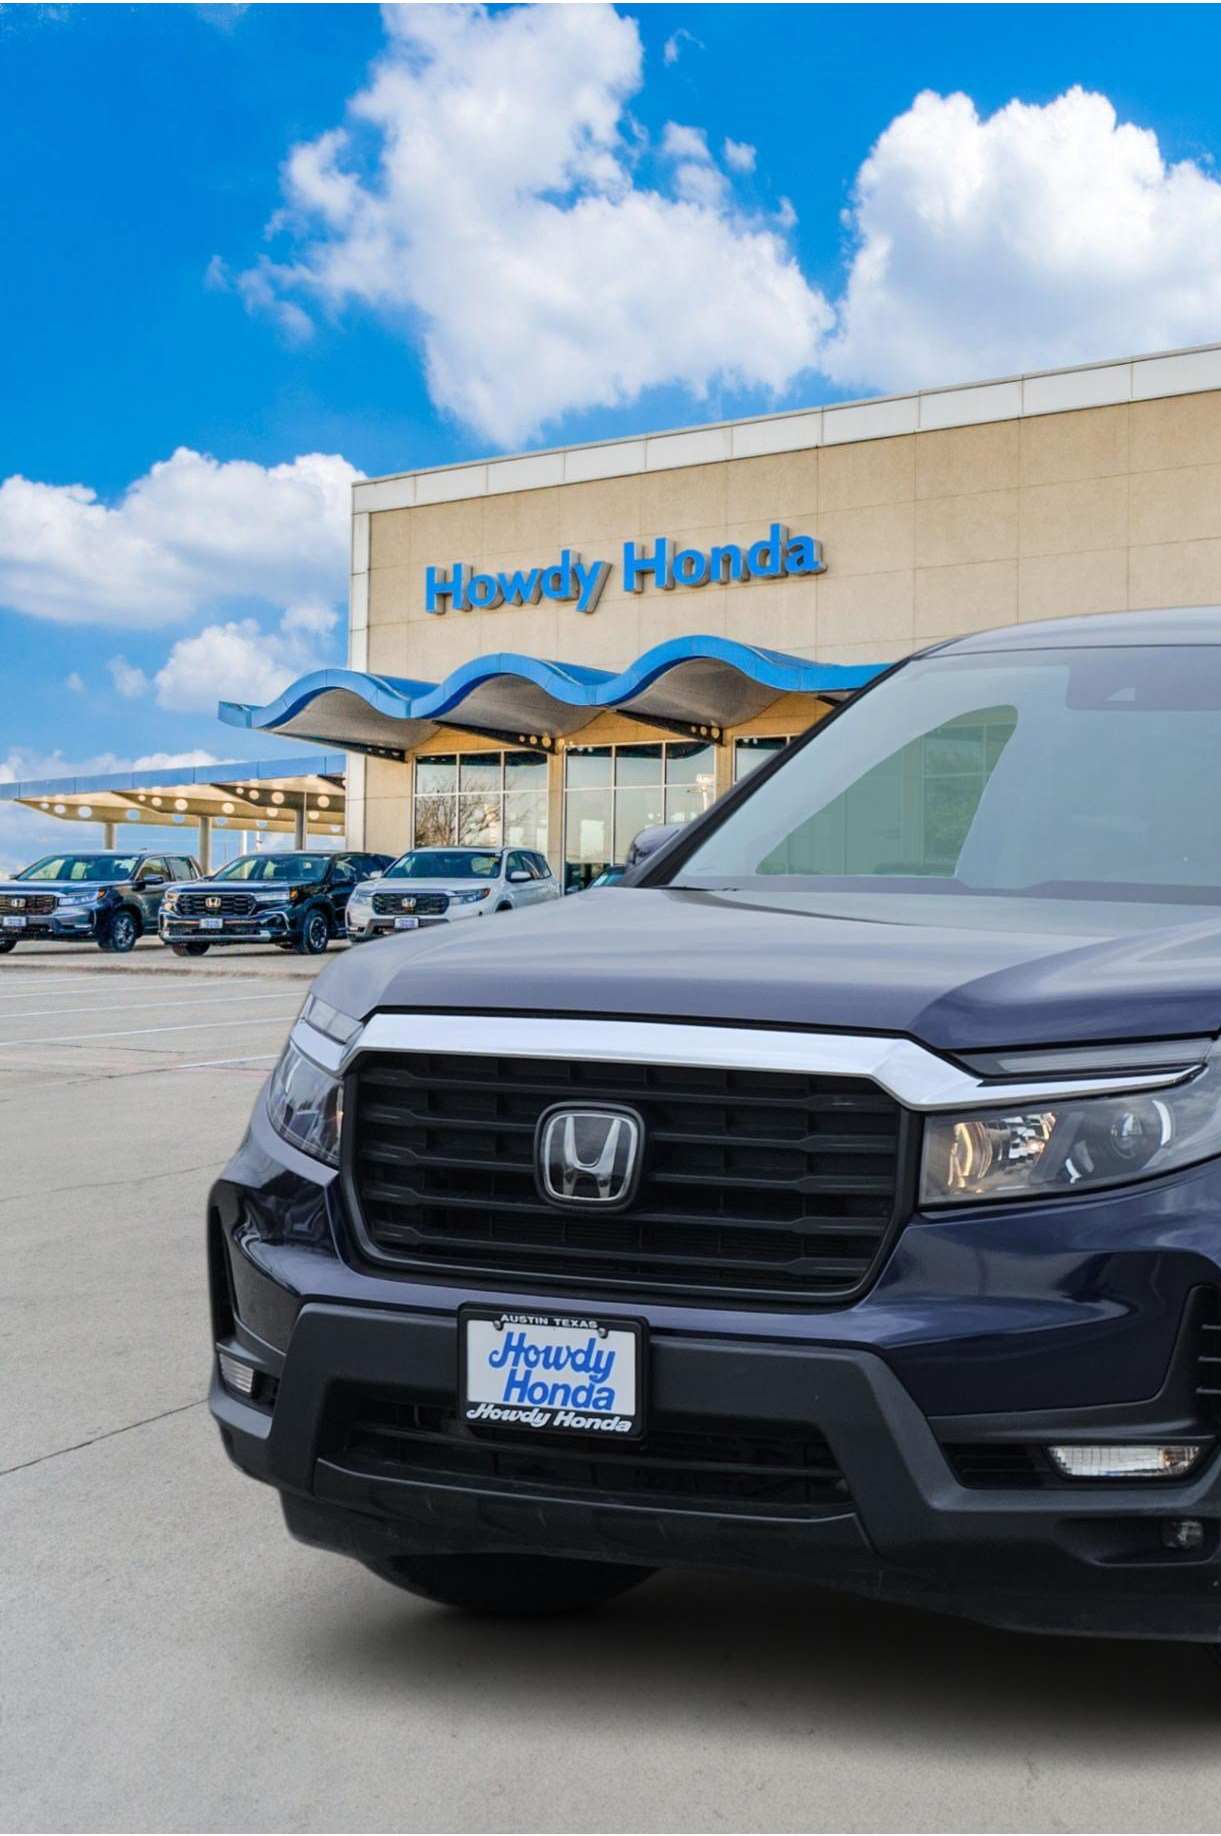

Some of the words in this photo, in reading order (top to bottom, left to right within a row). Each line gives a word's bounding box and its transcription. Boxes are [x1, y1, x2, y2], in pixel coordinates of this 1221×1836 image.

[425, 548, 612, 615] Howdy
[623, 522, 827, 594] Honda
[500, 1313, 549, 1326] AUSTIN
[553, 1317, 599, 1329] TEXAS
[488, 1331, 616, 1383] Howdy
[502, 1368, 616, 1411] Honda
[466, 1403, 551, 1428] Howdy
[552, 1410, 633, 1433] Honda
